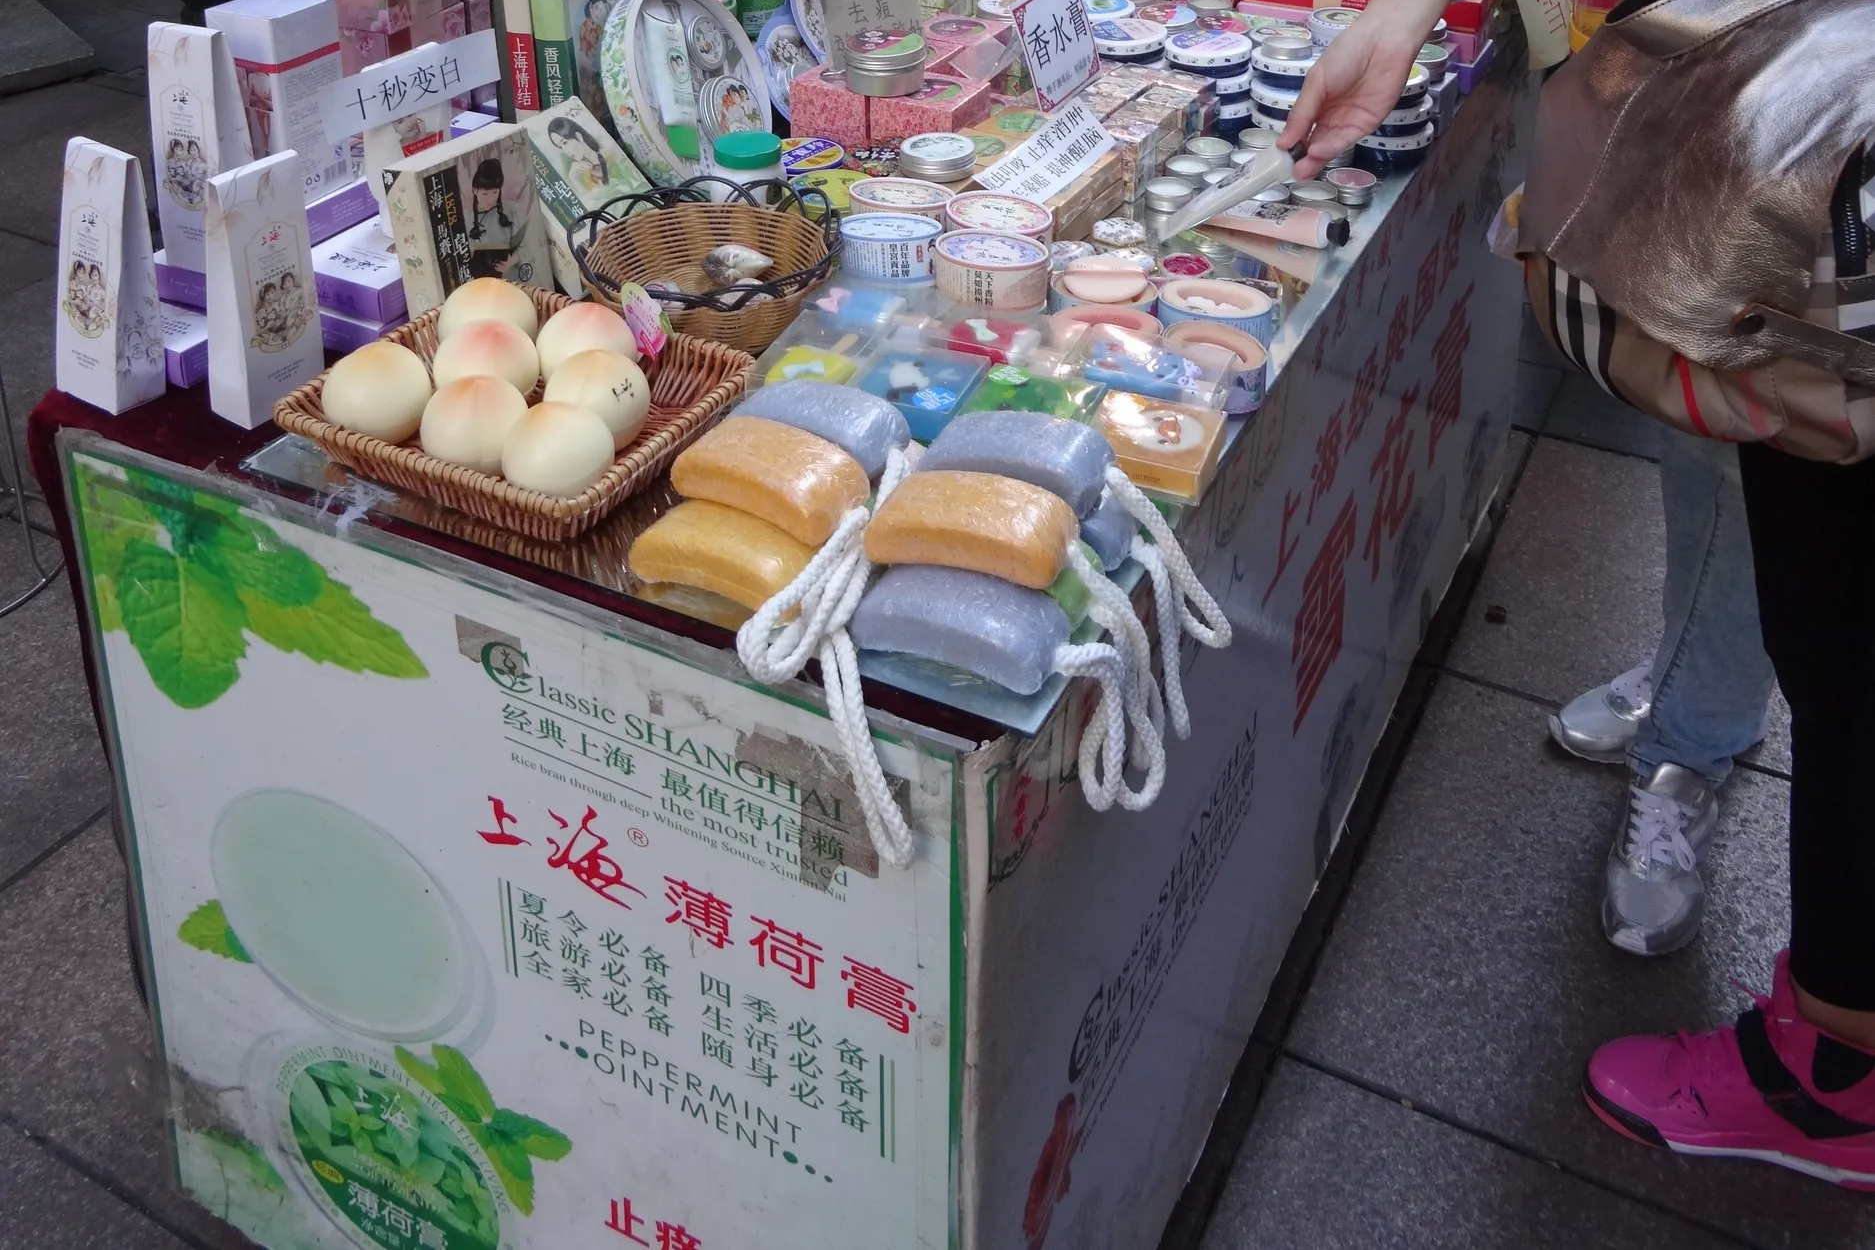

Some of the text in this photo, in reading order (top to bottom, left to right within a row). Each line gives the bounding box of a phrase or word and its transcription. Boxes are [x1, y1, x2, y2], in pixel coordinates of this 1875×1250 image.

[345, 55, 462, 122] 十秒变白
[512, 37, 533, 107] 上海情结
[1028, 105, 1085, 162] 止痒消肿
[1044, 126, 1104, 178] 提神醒脑
[445, 191, 458, 226] 1878
[900, 242, 911, 278] 百年品牌
[984, 271, 994, 306] 天下香粉
[1292, 279, 1476, 738] 雪花膏
[481, 641, 846, 825] Classic SHANGHAI
[502, 702, 637, 778] 经典上海
[511, 751, 537, 771] Rice
[539, 764, 568, 781] bran
[570, 774, 617, 805] through
[619, 796, 650, 820] deep
[652, 811, 718, 849] Whitening
[721, 839, 766, 868] Source
[659, 794, 849, 887] the most trusted
[475, 794, 919, 1035] 上海 薄荷膏
[516, 886, 871, 1073] 夏令必备 四季必备
[519, 919, 871, 1104] 旅游必备 生活必备
[521, 950, 872, 1135] 全家必备 随身必备
[578, 1018, 802, 1144] PEPPERMINT
[276, 1045, 327, 1094] PEPPERMINT
[332, 1046, 411, 1088] OINTMENT
[419, 1088, 480, 1156] HEALTHY
[480, 1159, 511, 1215] LIVING
[593, 1051, 780, 1159] OINTMENT
[347, 1178, 449, 1250] 薄荷膏
